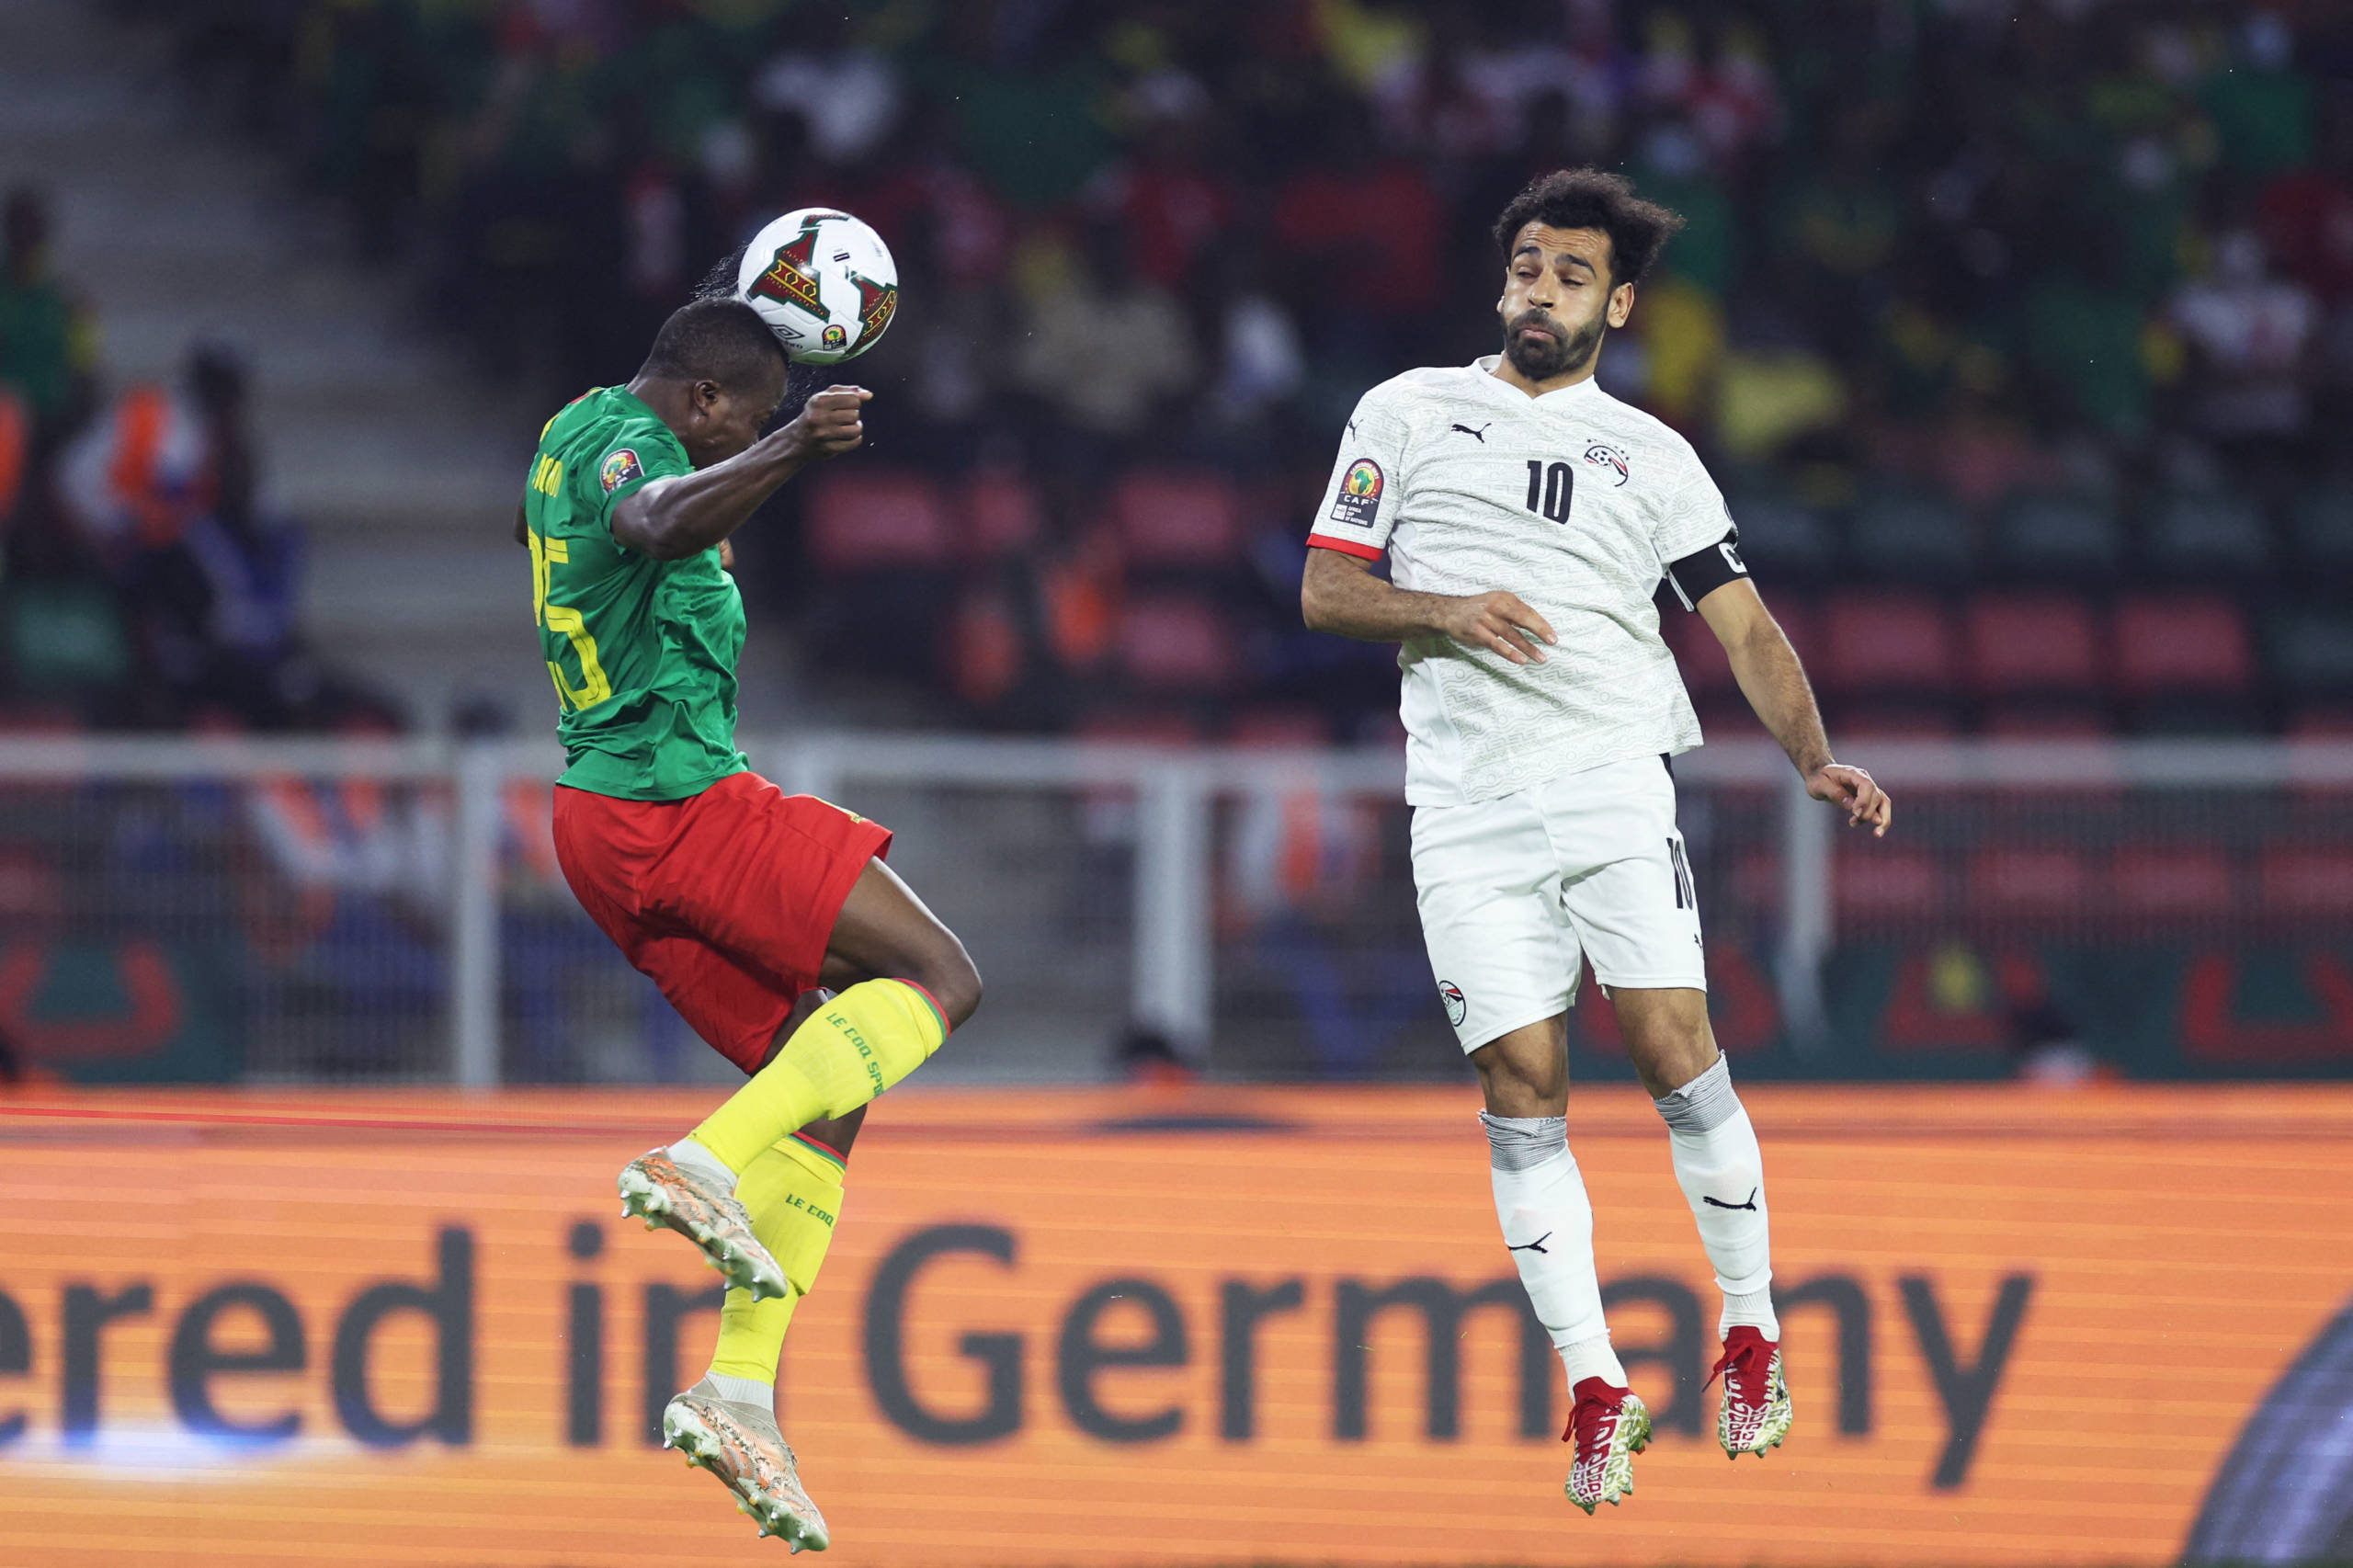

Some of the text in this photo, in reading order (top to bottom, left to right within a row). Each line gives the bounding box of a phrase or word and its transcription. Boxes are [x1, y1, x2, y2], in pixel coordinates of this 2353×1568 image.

[1344, 494, 1370, 506] CAF
[1526, 459, 1574, 526] 10
[1718, 542, 1748, 574] C
[1666, 837, 1694, 911] 10
[825, 1012, 847, 1028] LE
[844, 1027, 872, 1059] COQ
[785, 1193, 835, 1228] LE COQ
[0, 1224, 472, 1449] red
[860, 1219, 2035, 1493] Germany
